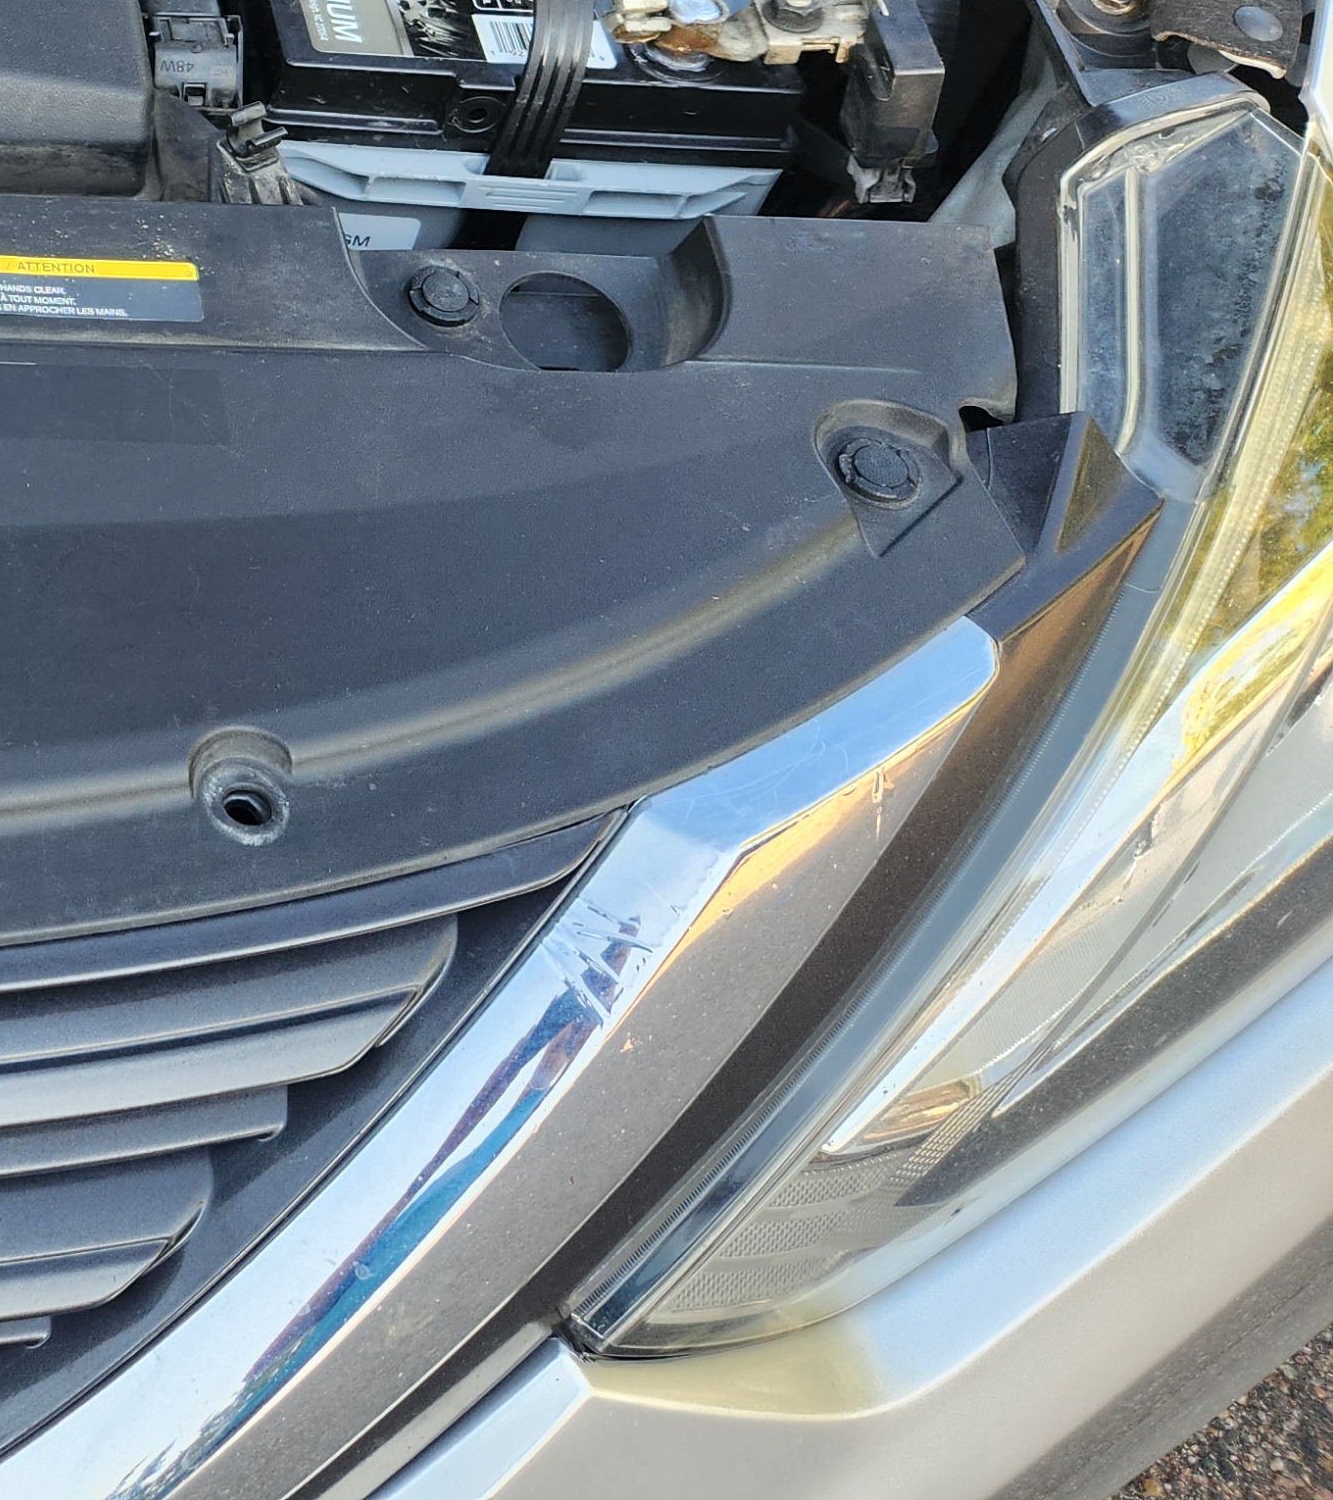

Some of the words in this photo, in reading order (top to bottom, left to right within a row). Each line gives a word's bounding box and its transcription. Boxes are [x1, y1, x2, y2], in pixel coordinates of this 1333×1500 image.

[17, 261, 96, 274] ATTENTION
[0, 284, 32, 293] HANDS
[34, 286, 67, 295] CLEAR.
[1, 293, 8, 301] À
[9, 294, 33, 303] TOUT
[34, 296, 77, 306] MOMENT.
[4, 304, 16, 312] EN
[18, 305, 76, 315] APPROCHER
[77, 307, 94, 316] LES
[96, 308, 128, 317] MAINS.
